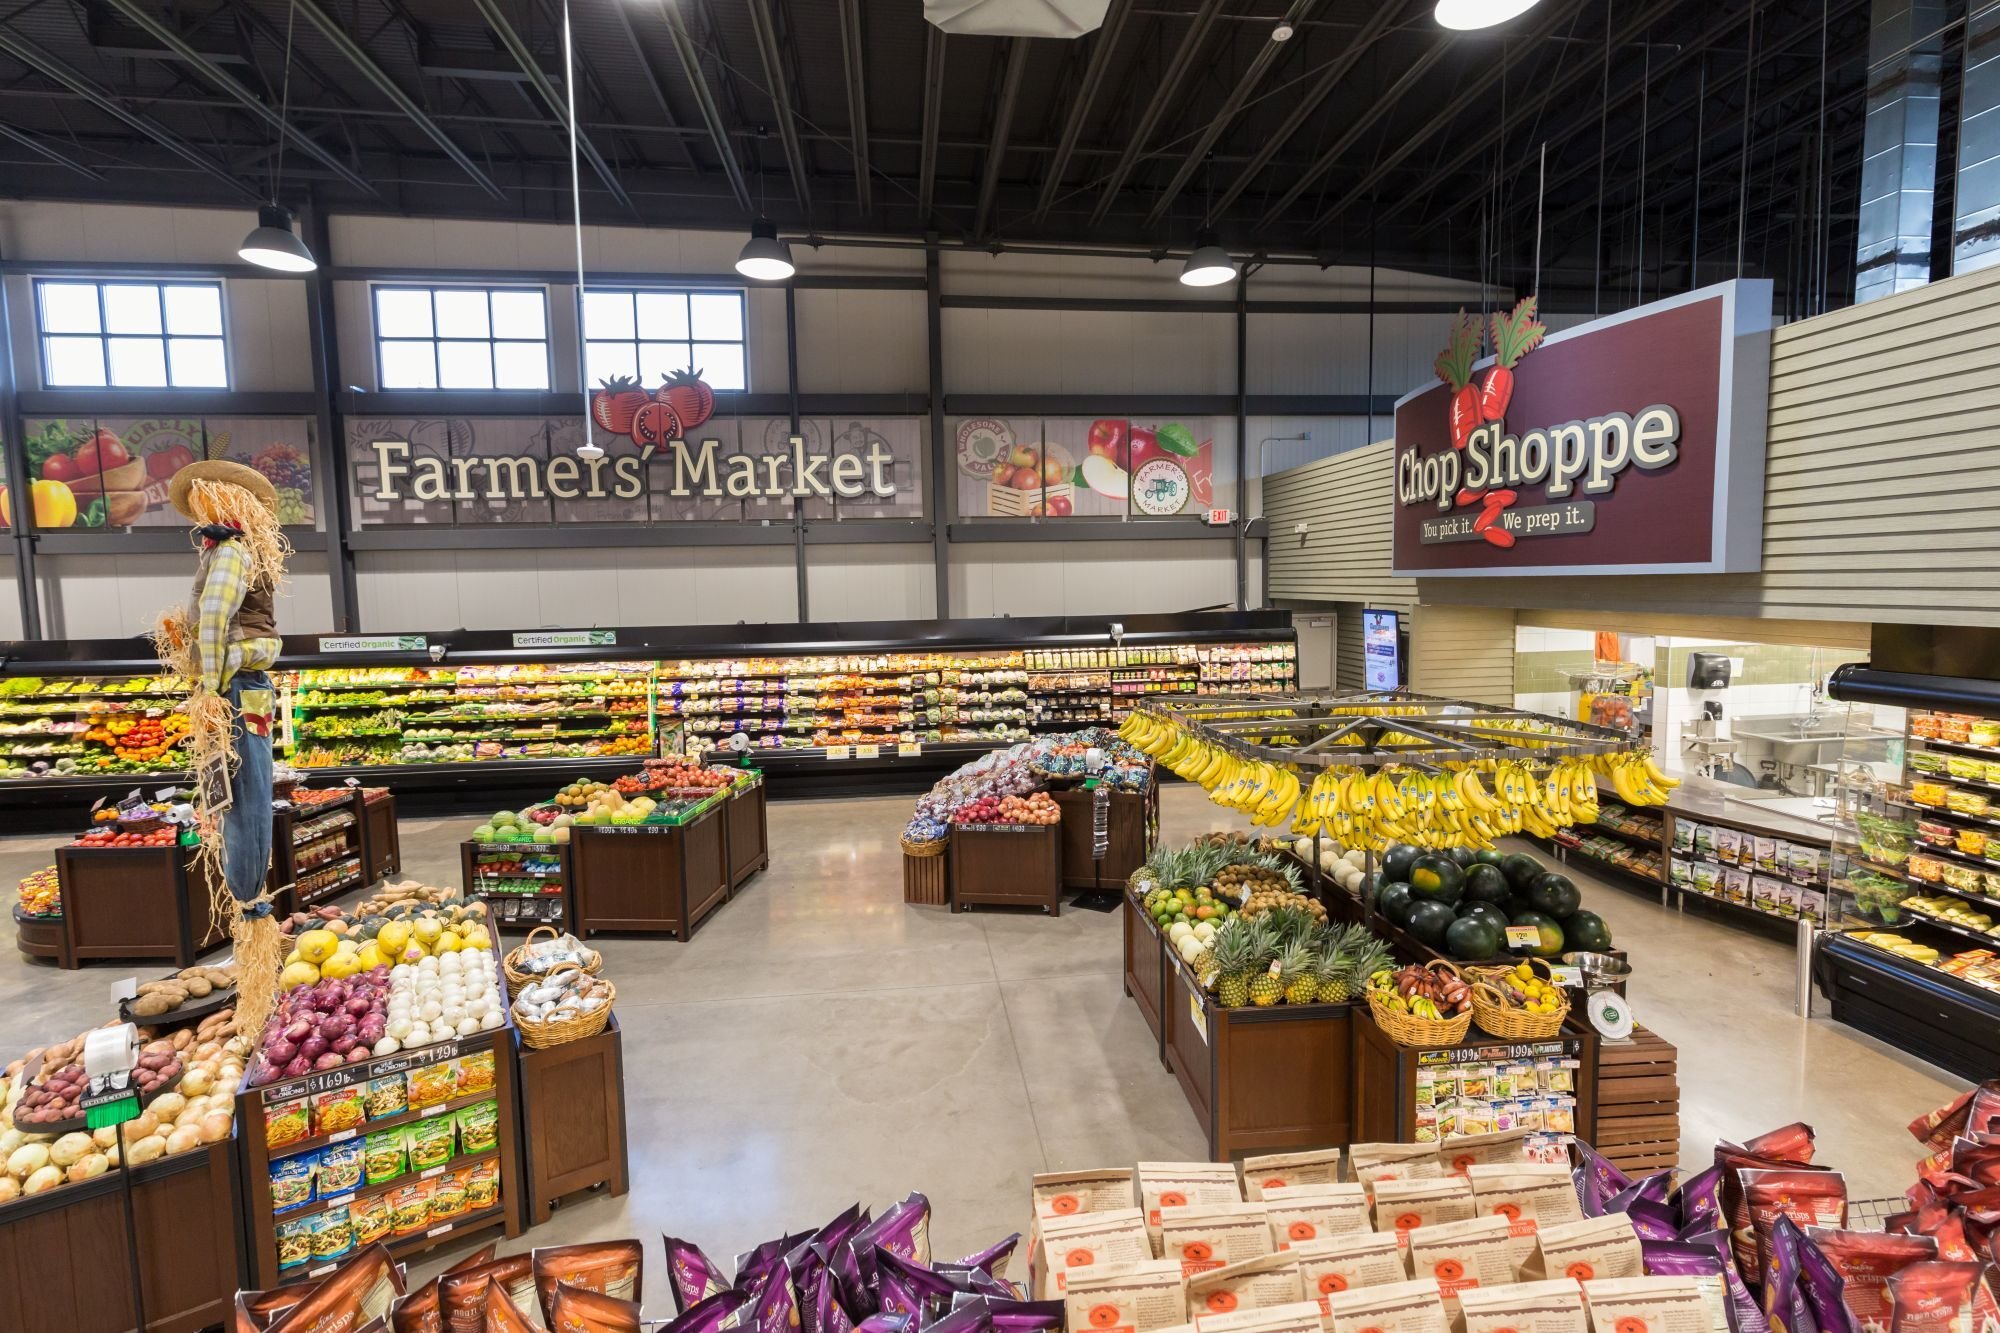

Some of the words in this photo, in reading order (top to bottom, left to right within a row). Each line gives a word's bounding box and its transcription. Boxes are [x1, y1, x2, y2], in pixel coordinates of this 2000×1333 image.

[960, 421, 1001, 450] WHOLESOME
[669, 437, 895, 497] Market
[1400, 450, 1458, 508] Chop
[1467, 410, 1675, 493] Shoppe
[1140, 463, 1184, 482] FARMER'S
[1143, 499, 1182, 513] MARKET
[1213, 511, 1228, 521] EXIT
[1503, 512, 1522, 530] We
[1526, 512, 1560, 532] prep
[1565, 506, 1585, 525] it.
[1424, 523, 1438, 538] You
[1440, 519, 1458, 539] pick
[1461, 518, 1473, 534] it.
[324, 640, 360, 649] Certified
[361, 640, 395, 649] Organic
[517, 636, 552, 645] Certified
[553, 635, 586, 643] Organic
[613, 817, 641, 825] ORGANIC
